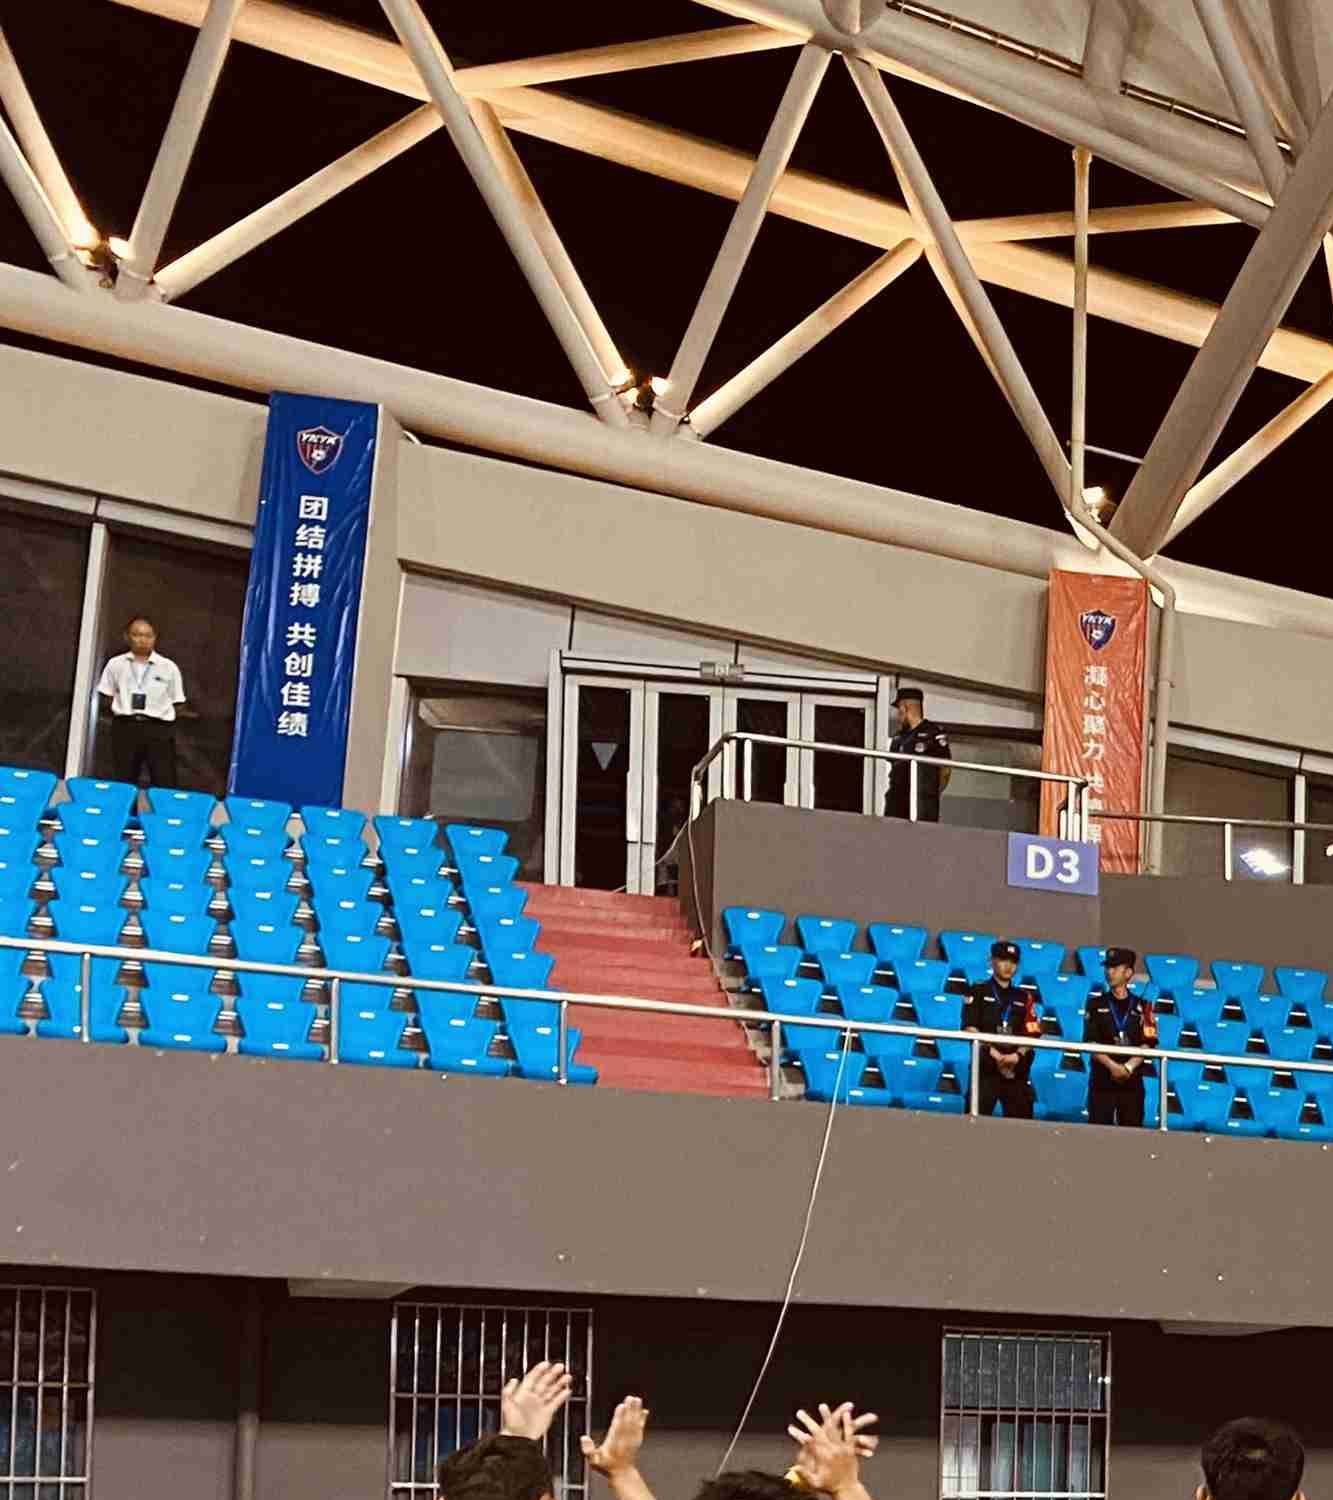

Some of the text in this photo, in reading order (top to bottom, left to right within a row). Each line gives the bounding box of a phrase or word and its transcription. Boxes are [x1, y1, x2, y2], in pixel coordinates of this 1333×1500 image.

[276, 495, 329, 738] 团结拼搏 共创佳绩
[1026, 844, 1081, 884] D3
